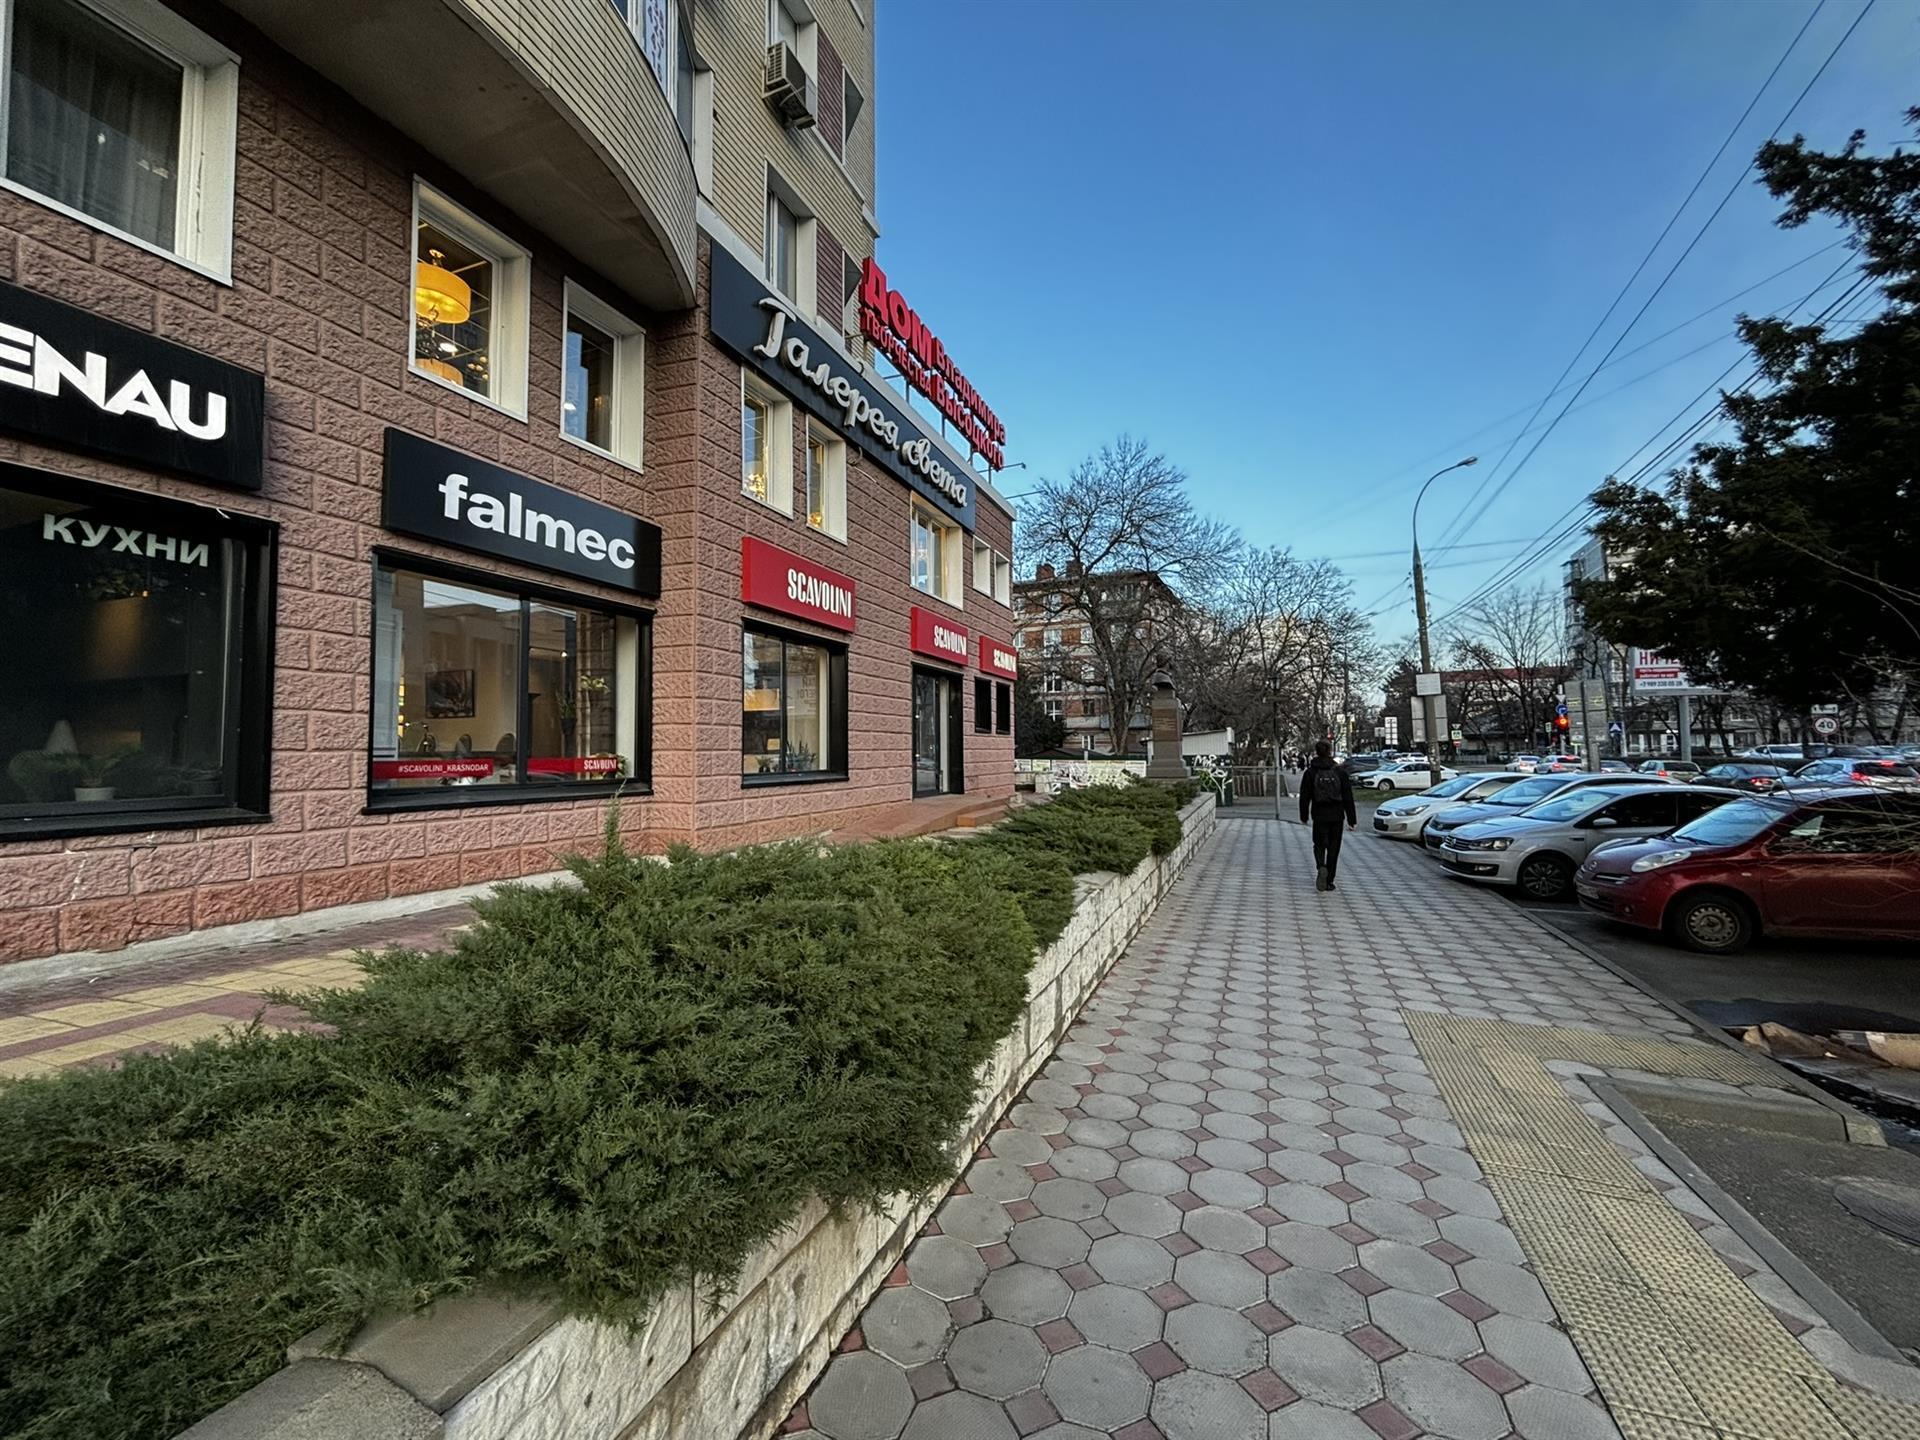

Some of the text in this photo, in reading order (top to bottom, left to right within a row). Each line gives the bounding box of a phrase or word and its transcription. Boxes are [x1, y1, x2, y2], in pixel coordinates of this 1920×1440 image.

[0, 322, 227, 440] ENAU
[861, 256, 1006, 446] ДОМ Владимира
[753, 297, 968, 508] Галерея света
[860, 307, 1004, 472] ТВОРЧЕСТВА Высоцкого
[438, 473, 635, 569] falmec
[787, 568, 852, 618] SCAVOLINI
[933, 625, 967, 657] SCAVOLINI
[1818, 720, 1834, 729] 40
[398, 763, 489, 774] #SCAVOLINI_KRASNODAR
[583, 759, 617, 771] SCAVOLINI
